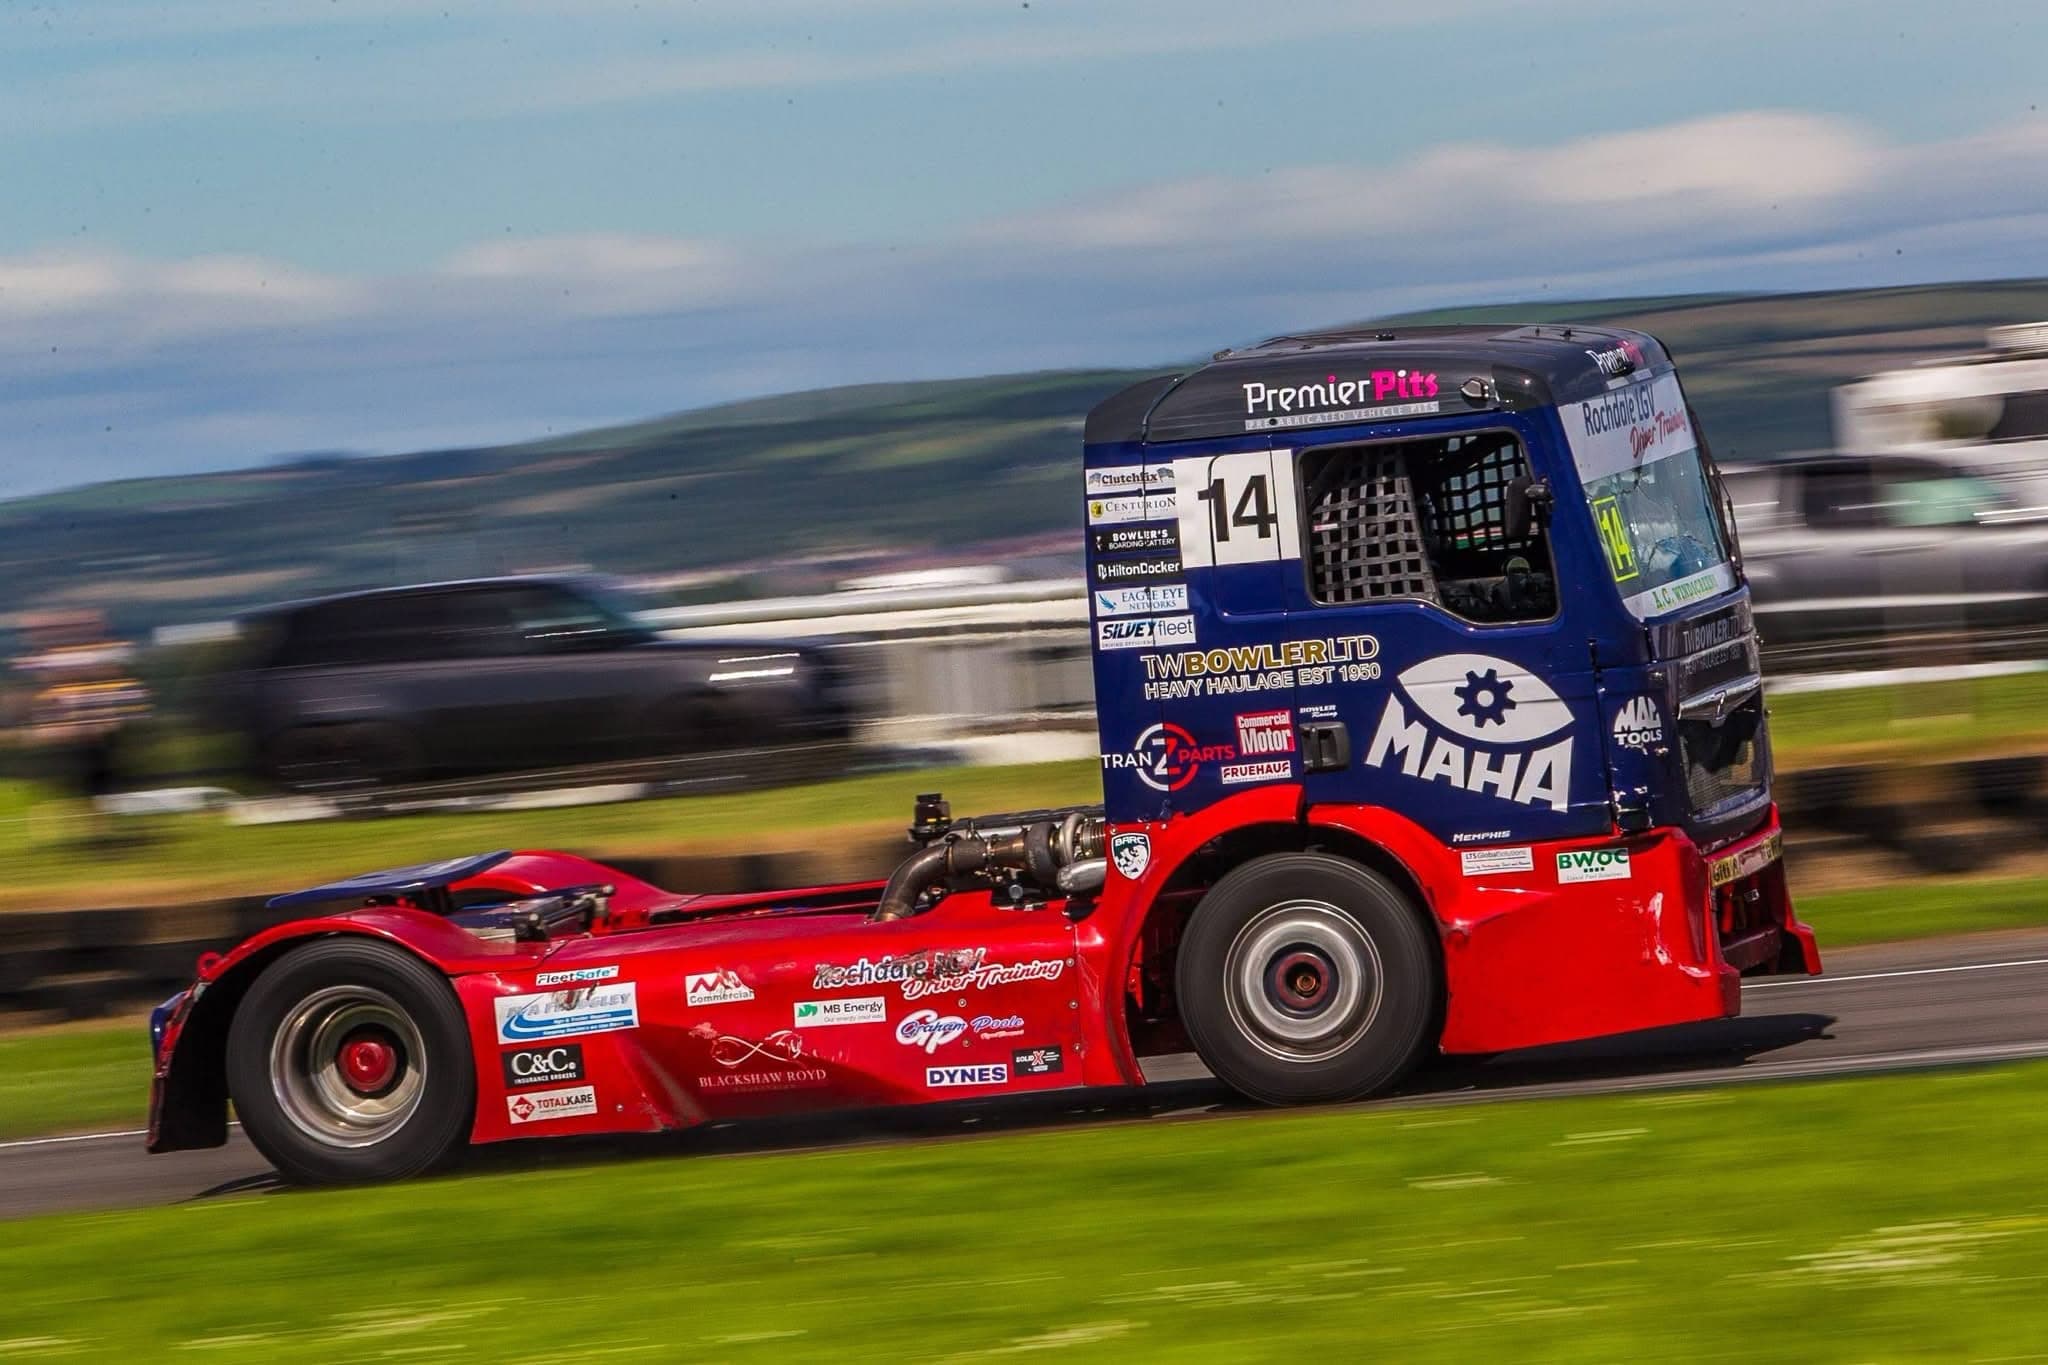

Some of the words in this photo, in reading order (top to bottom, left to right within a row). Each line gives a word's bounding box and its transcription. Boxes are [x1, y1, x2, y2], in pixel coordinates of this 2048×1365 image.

[1582, 387, 1636, 437] Rochdale
[1635, 383, 1657, 421] LGV
[1630, 425, 1656, 459] Driver
[1105, 496, 1177, 512] CENTURION
[1197, 474, 1279, 544] 14
[1112, 528, 1169, 542] BOWLER'S
[1600, 506, 1634, 571] 14
[1108, 562, 1180, 577] HiltonDocker
[1162, 587, 1185, 600] EYE
[1129, 599, 1177, 611] NETWORKS
[1145, 677, 1203, 700] HEAVY
[1207, 669, 1294, 696] HAULAGE
[1298, 666, 1336, 685] EST
[1338, 661, 1382, 682] 1950
[1300, 704, 1337, 713] BOWLER
[1614, 696, 1662, 732] MAC
[1238, 712, 1290, 729] Commercial
[1241, 727, 1293, 756] Motor
[1614, 728, 1663, 746] TOOLS
[1179, 744, 1236, 764] PARTS
[1365, 692, 1574, 813] MAHA
[1223, 761, 1290, 778] FRUEHAUF
[1114, 835, 1146, 848] BARC
[1559, 848, 1629, 869] BWOC
[901, 970, 973, 1000] Driver
[974, 959, 1064, 990] Training
[690, 991, 753, 1004] Commercial
[823, 1004, 841, 1014] MB
[843, 1002, 883, 1013] Energy
[901, 1021, 967, 1039] Graham
[970, 1015, 1025, 1033] Poole
[514, 1075, 549, 1085] INSURANCE
[550, 1072, 577, 1080] BROKERS
[699, 1070, 783, 1088] BLACKSHAW
[787, 1069, 827, 1082] ROYD
[929, 1067, 1006, 1084] DYNES
[536, 1094, 593, 1109] TOTALKARE
